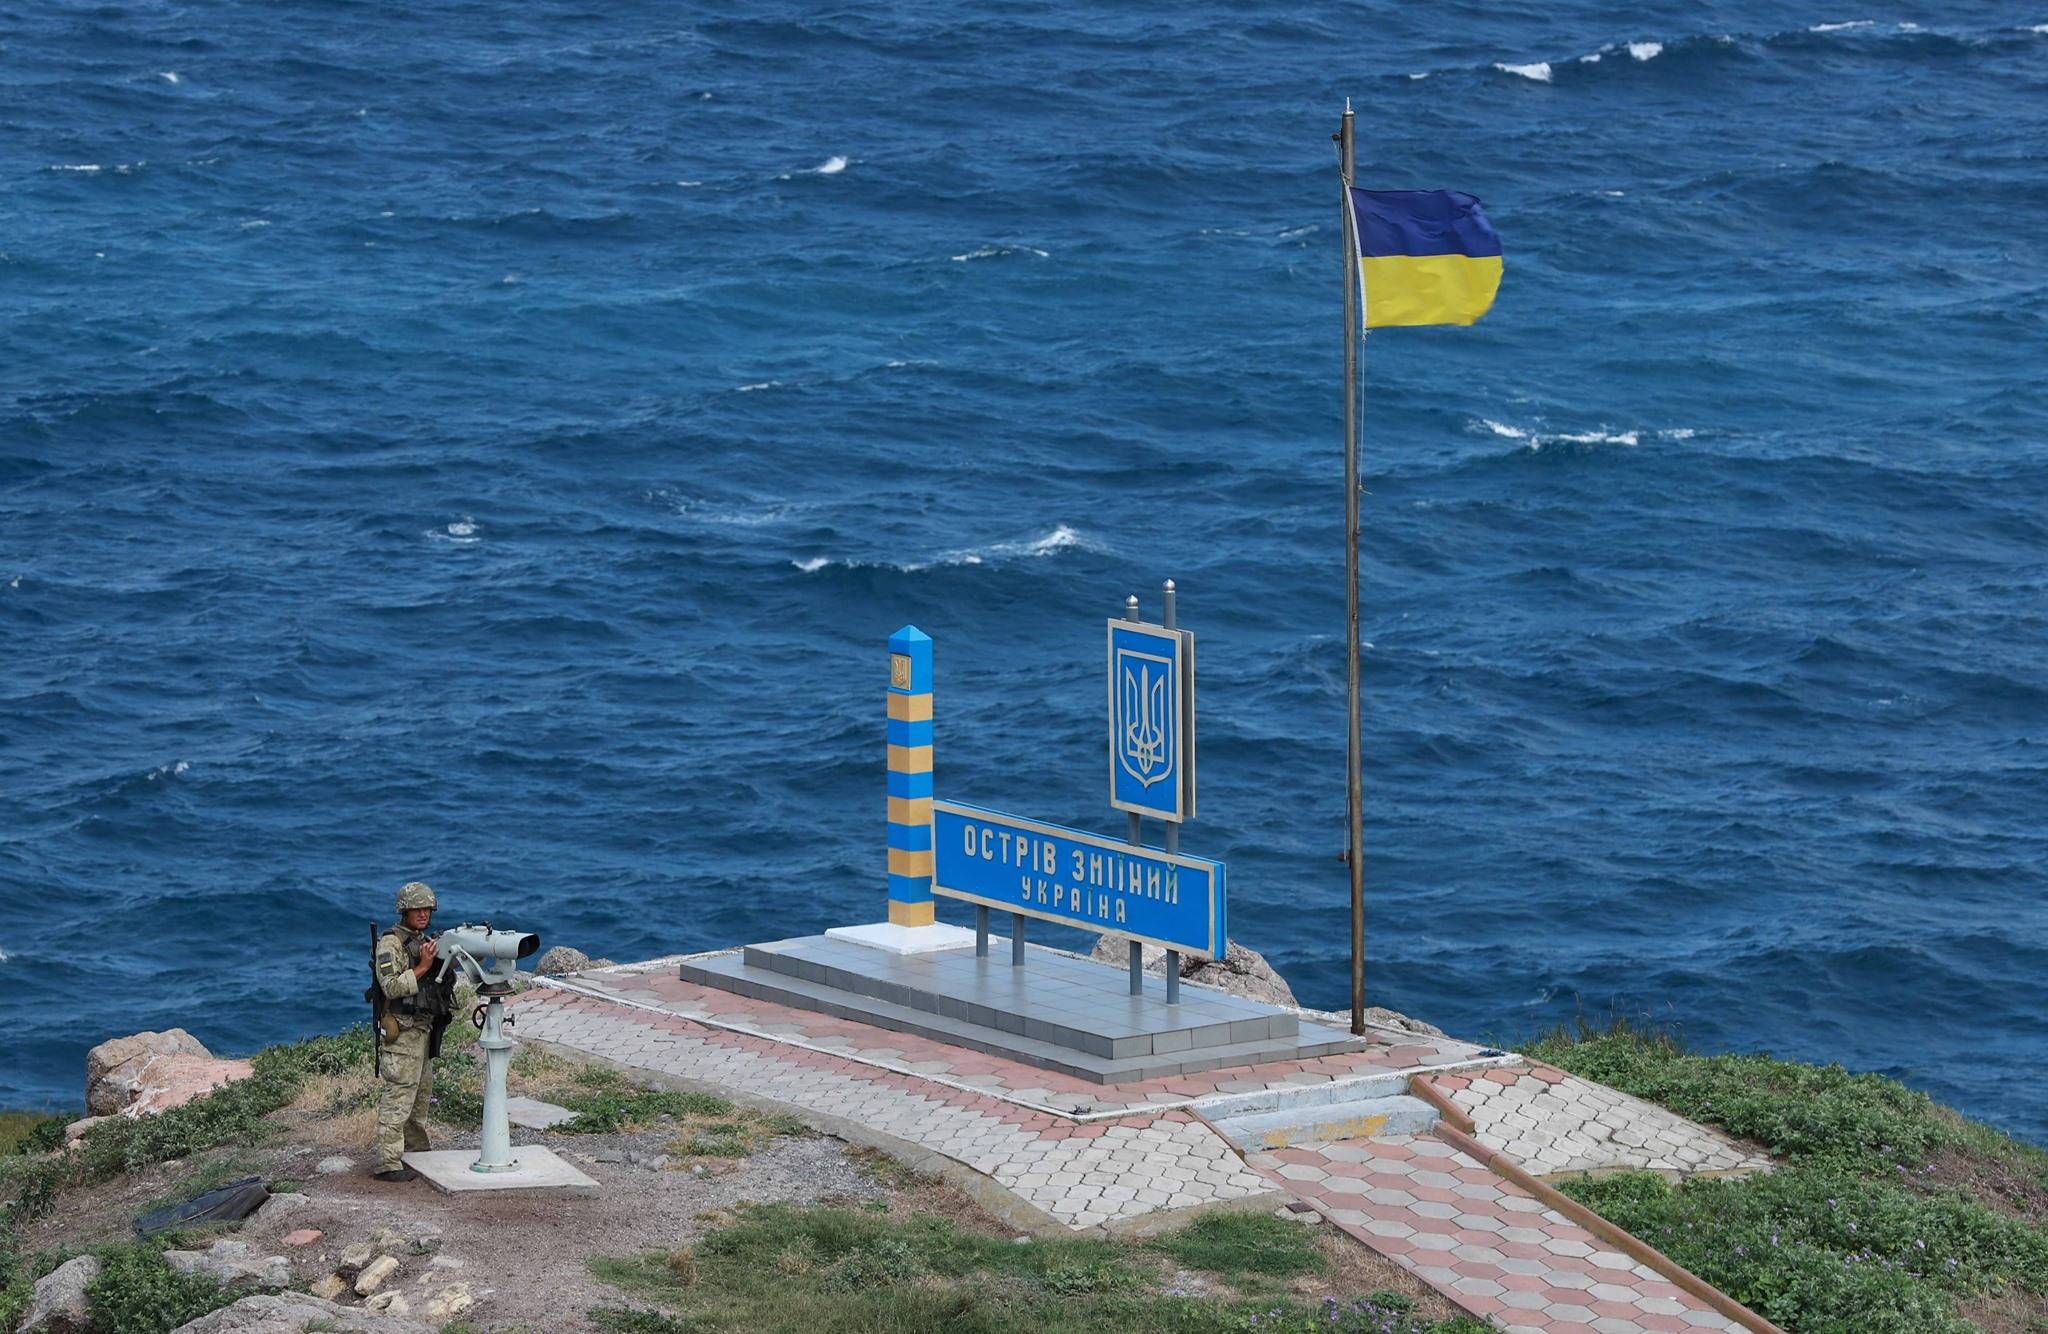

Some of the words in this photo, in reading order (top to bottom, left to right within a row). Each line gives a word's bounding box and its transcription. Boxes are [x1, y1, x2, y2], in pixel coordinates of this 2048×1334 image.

[964, 825, 1057, 875] ОСТРІВ
[1071, 849, 1178, 905] ЗМІЇНИЙ
[1021, 875, 1127, 923] УКРАЇНА
